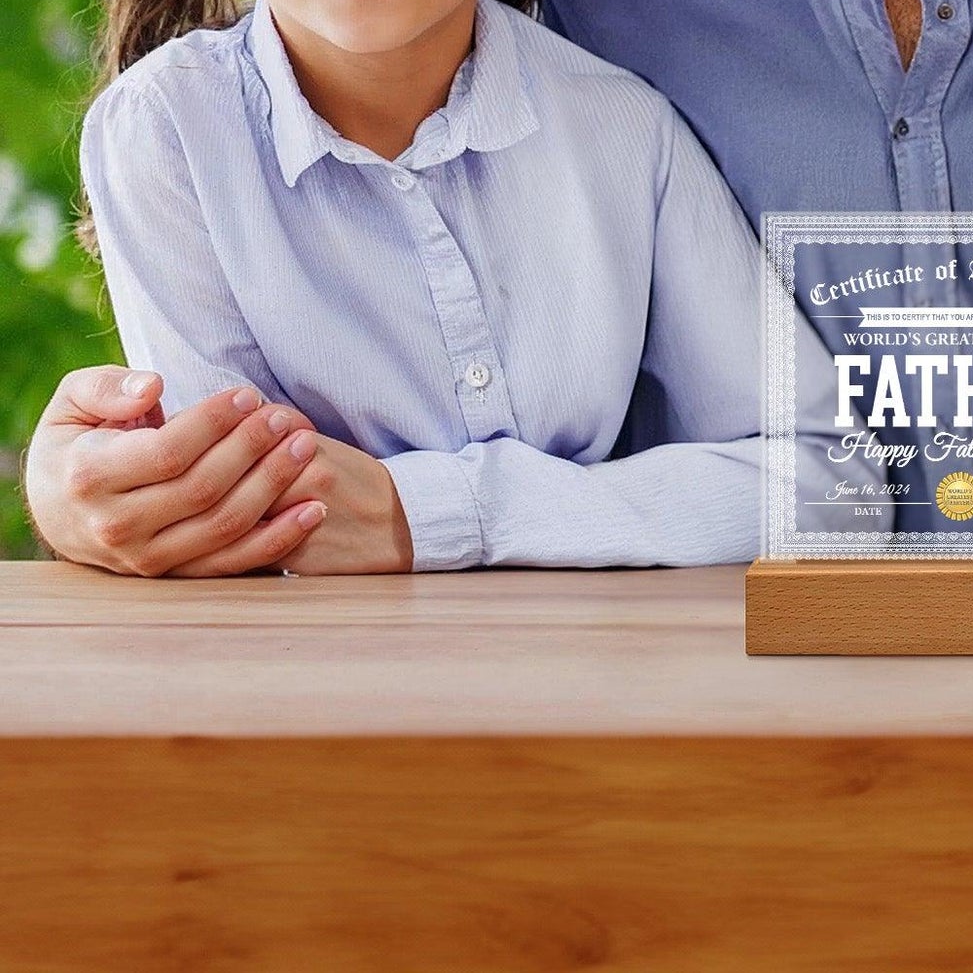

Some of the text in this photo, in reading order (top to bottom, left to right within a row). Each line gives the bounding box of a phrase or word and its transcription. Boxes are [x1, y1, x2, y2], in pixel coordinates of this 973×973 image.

[810, 264, 924, 306] Certificate
[935, 260, 958, 281] of
[866, 313, 882, 321] THIS
[883, 313, 890, 321] IS
[892, 313, 901, 321] TO
[902, 313, 930, 321] CERTIFY
[932, 313, 949, 321] THAT
[951, 313, 965, 321] YOU
[844, 332, 921, 346] WORLD'S
[827, 431, 919, 467] Happy
[825, 480, 911, 500] June 16, 2024
[854, 507, 882, 516] DATE
